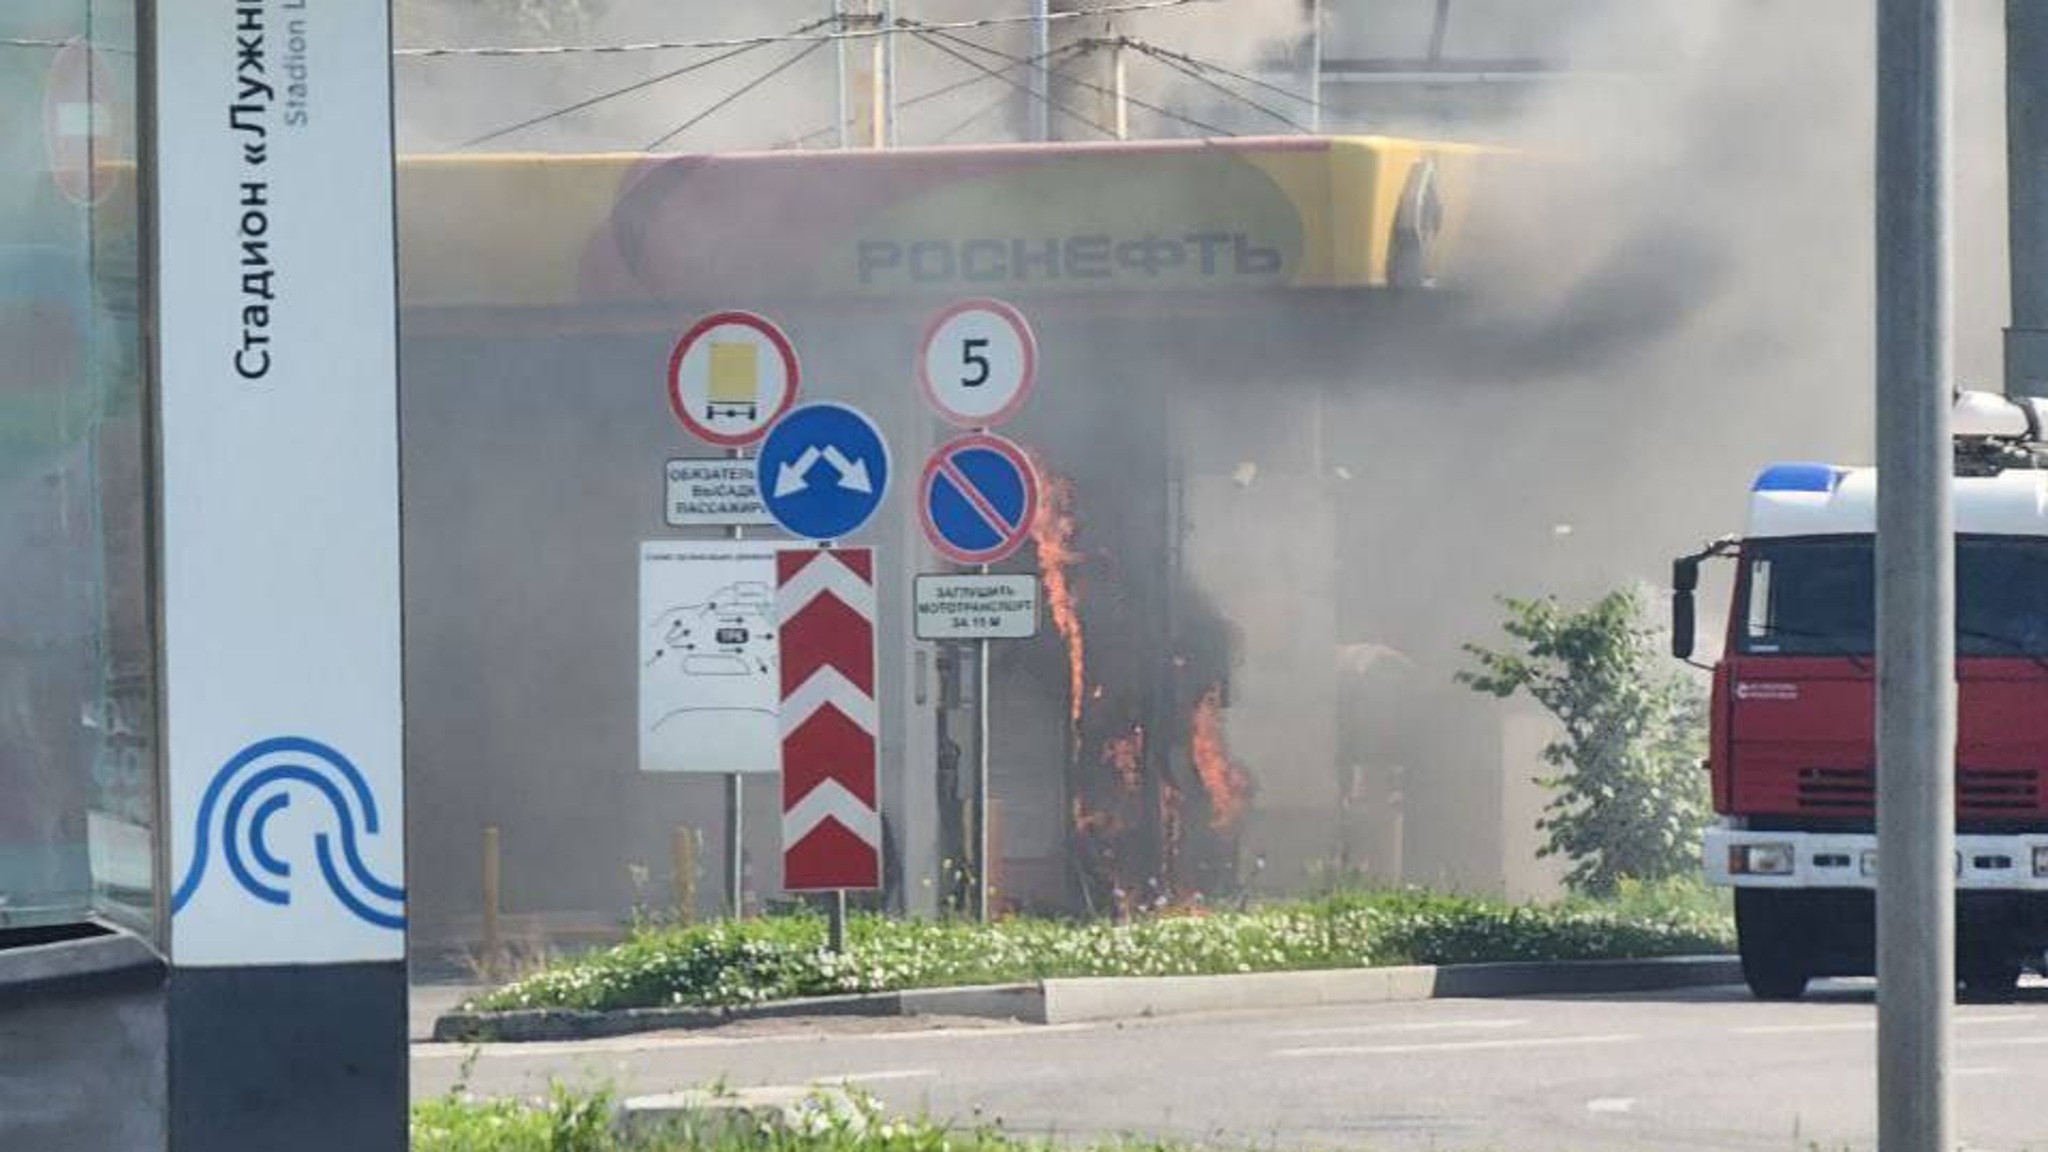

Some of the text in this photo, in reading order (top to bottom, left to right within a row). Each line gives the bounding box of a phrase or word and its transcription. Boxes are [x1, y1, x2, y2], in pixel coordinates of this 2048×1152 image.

[283, 20, 308, 126] Stadion
[229, 0, 274, 379] Стадион «Лужн
[856, 231, 1283, 284] РОСНЕФТЬ
[960, 339, 991, 387] 5
[676, 501, 766, 514] ПАССАЖИР
